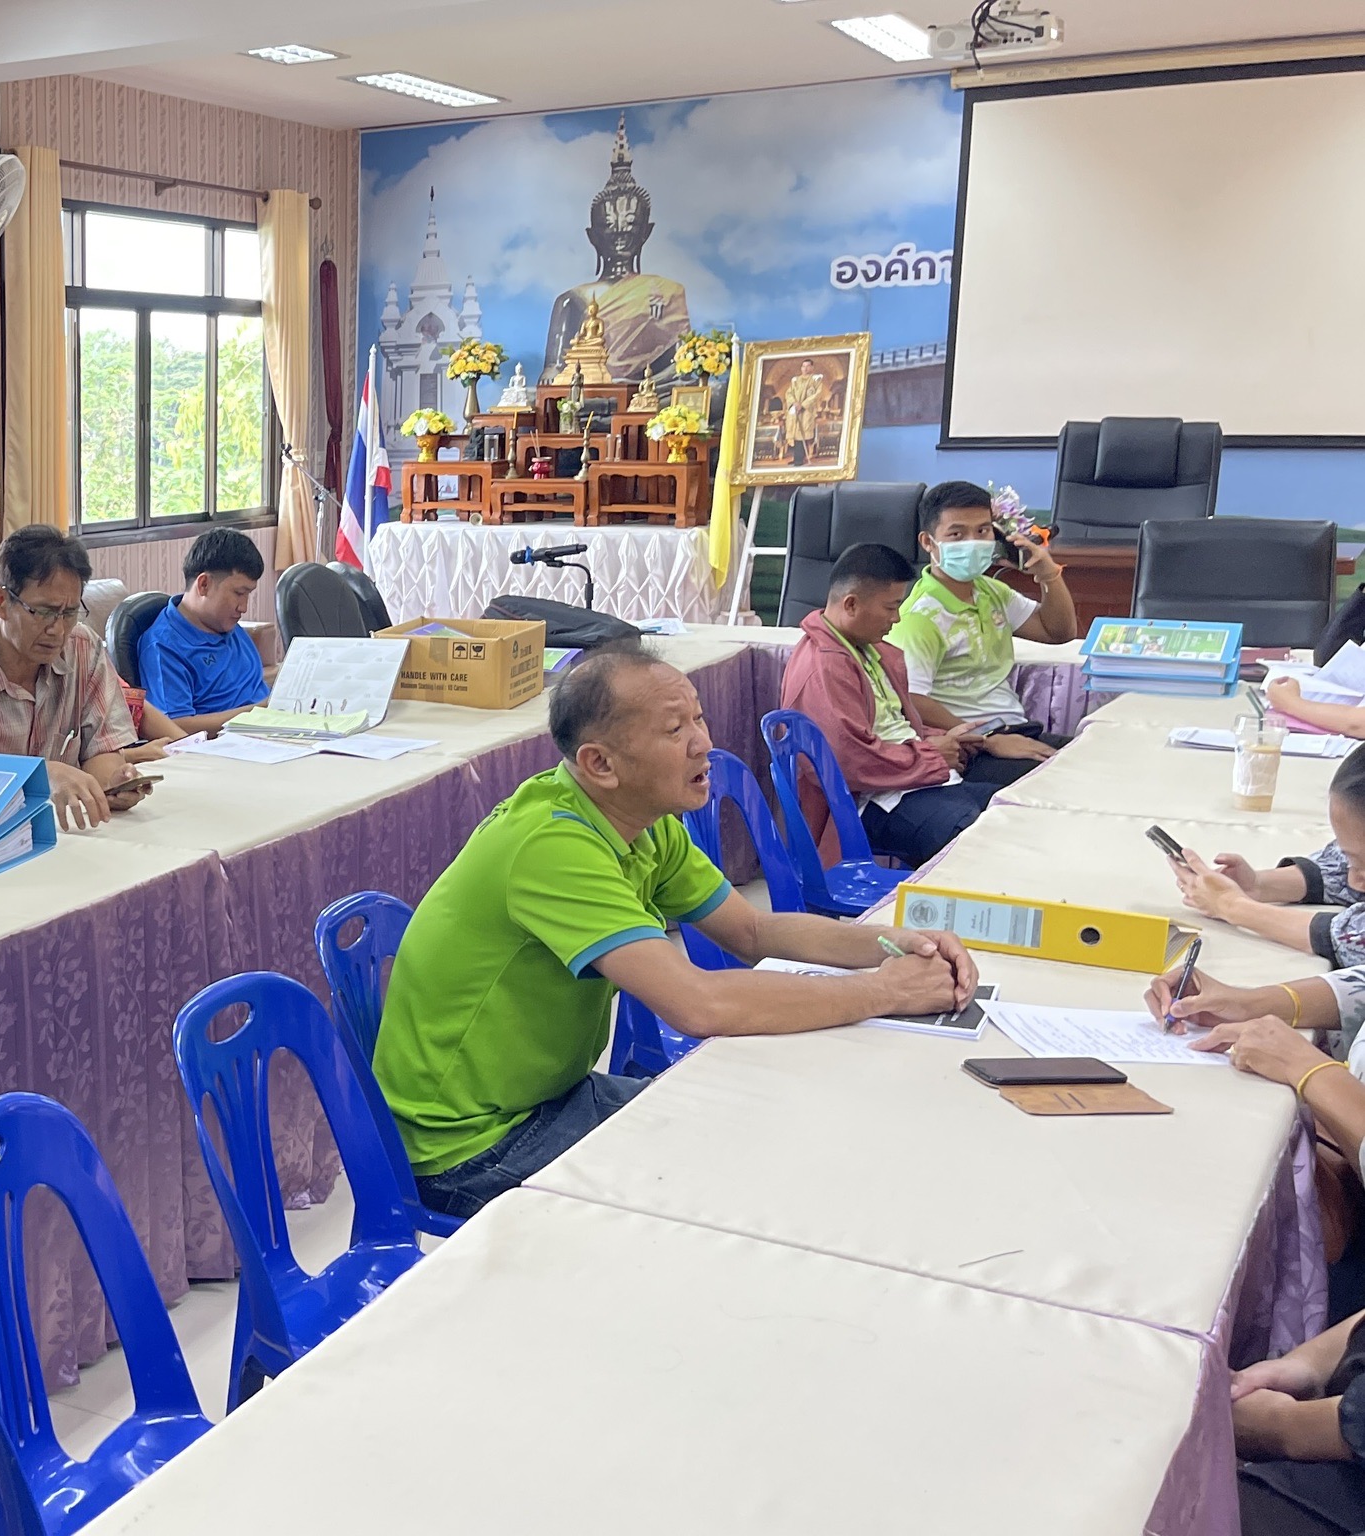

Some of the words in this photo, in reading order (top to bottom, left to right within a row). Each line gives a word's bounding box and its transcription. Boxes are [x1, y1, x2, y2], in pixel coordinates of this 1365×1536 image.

[400, 671, 426, 680] HANDLE
[430, 672, 447, 681] WITH
[450, 673, 468, 682] CARE
